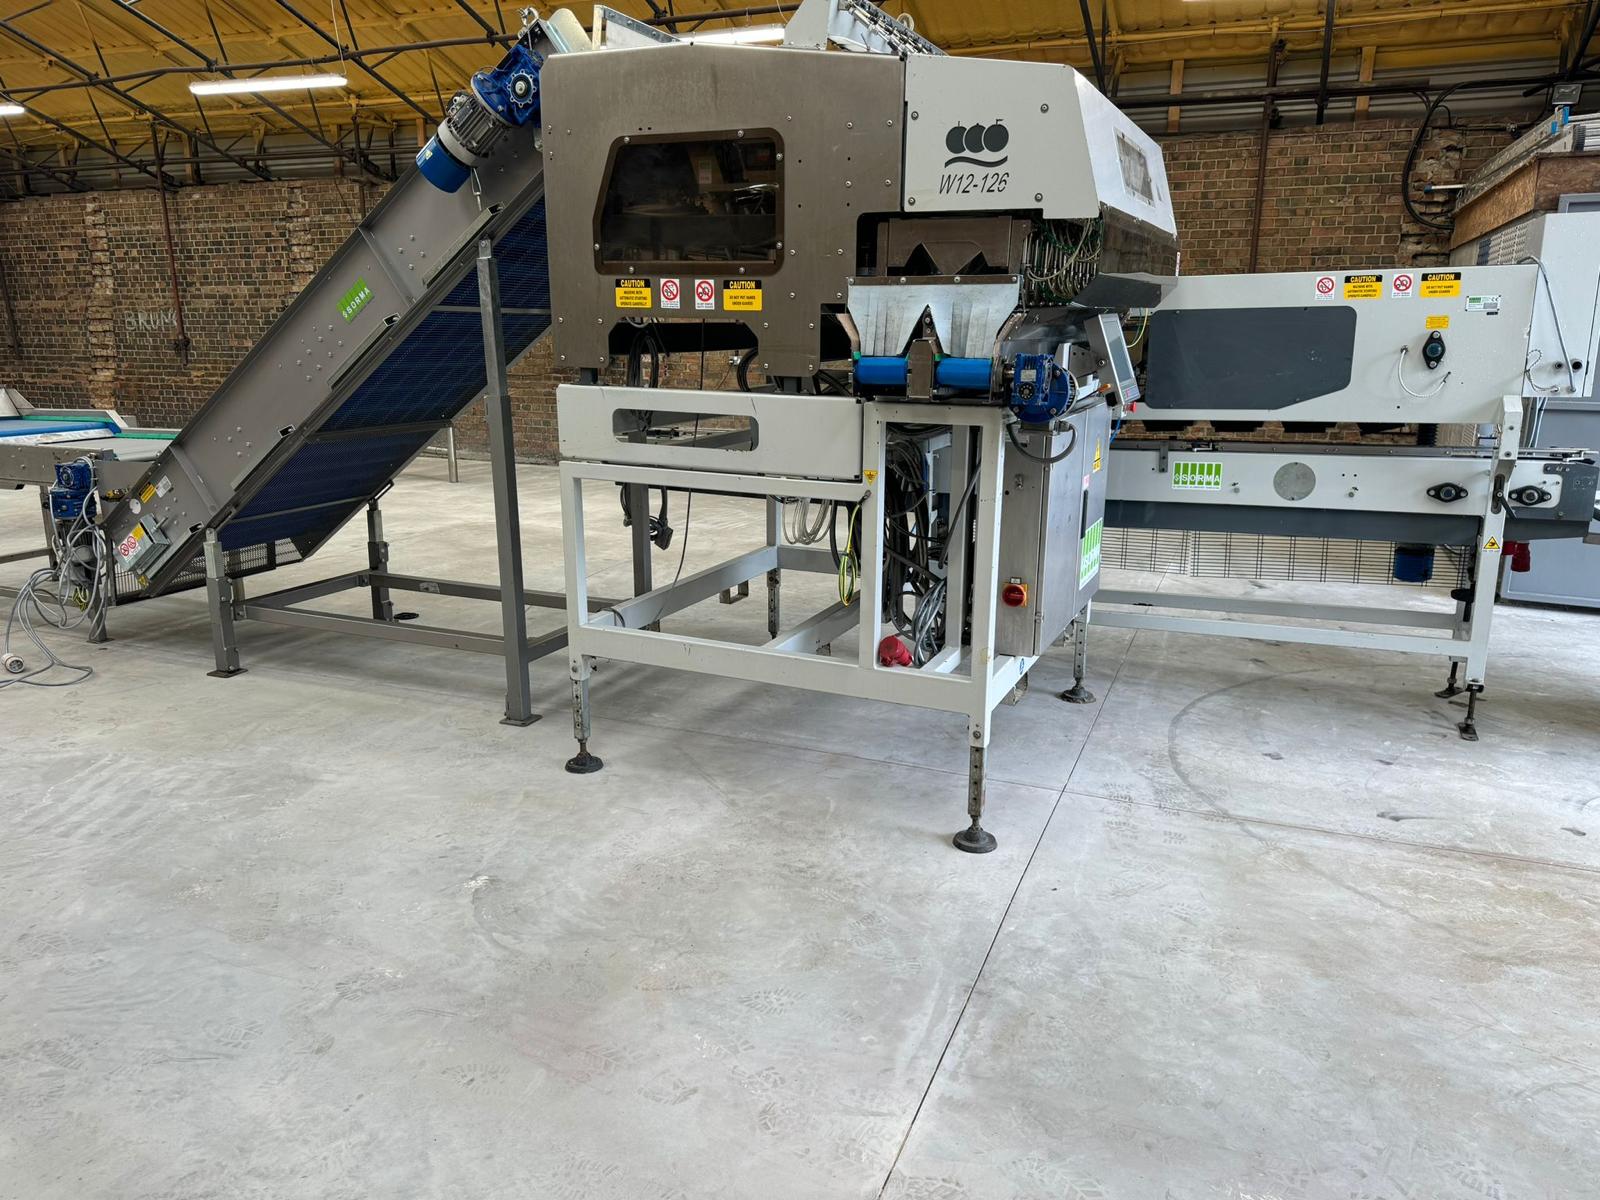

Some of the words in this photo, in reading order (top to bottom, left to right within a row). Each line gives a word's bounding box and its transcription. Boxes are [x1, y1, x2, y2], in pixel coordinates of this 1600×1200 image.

[939, 172, 1010, 194] W12-126
[1350, 275, 1377, 283] CAUTION
[1427, 273, 1455, 281] CAUTION
[620, 279, 645, 288] CAUTION
[729, 280, 756, 289] CAUTION
[346, 287, 370, 314] SORMA
[1182, 473, 1220, 482] SORMA
